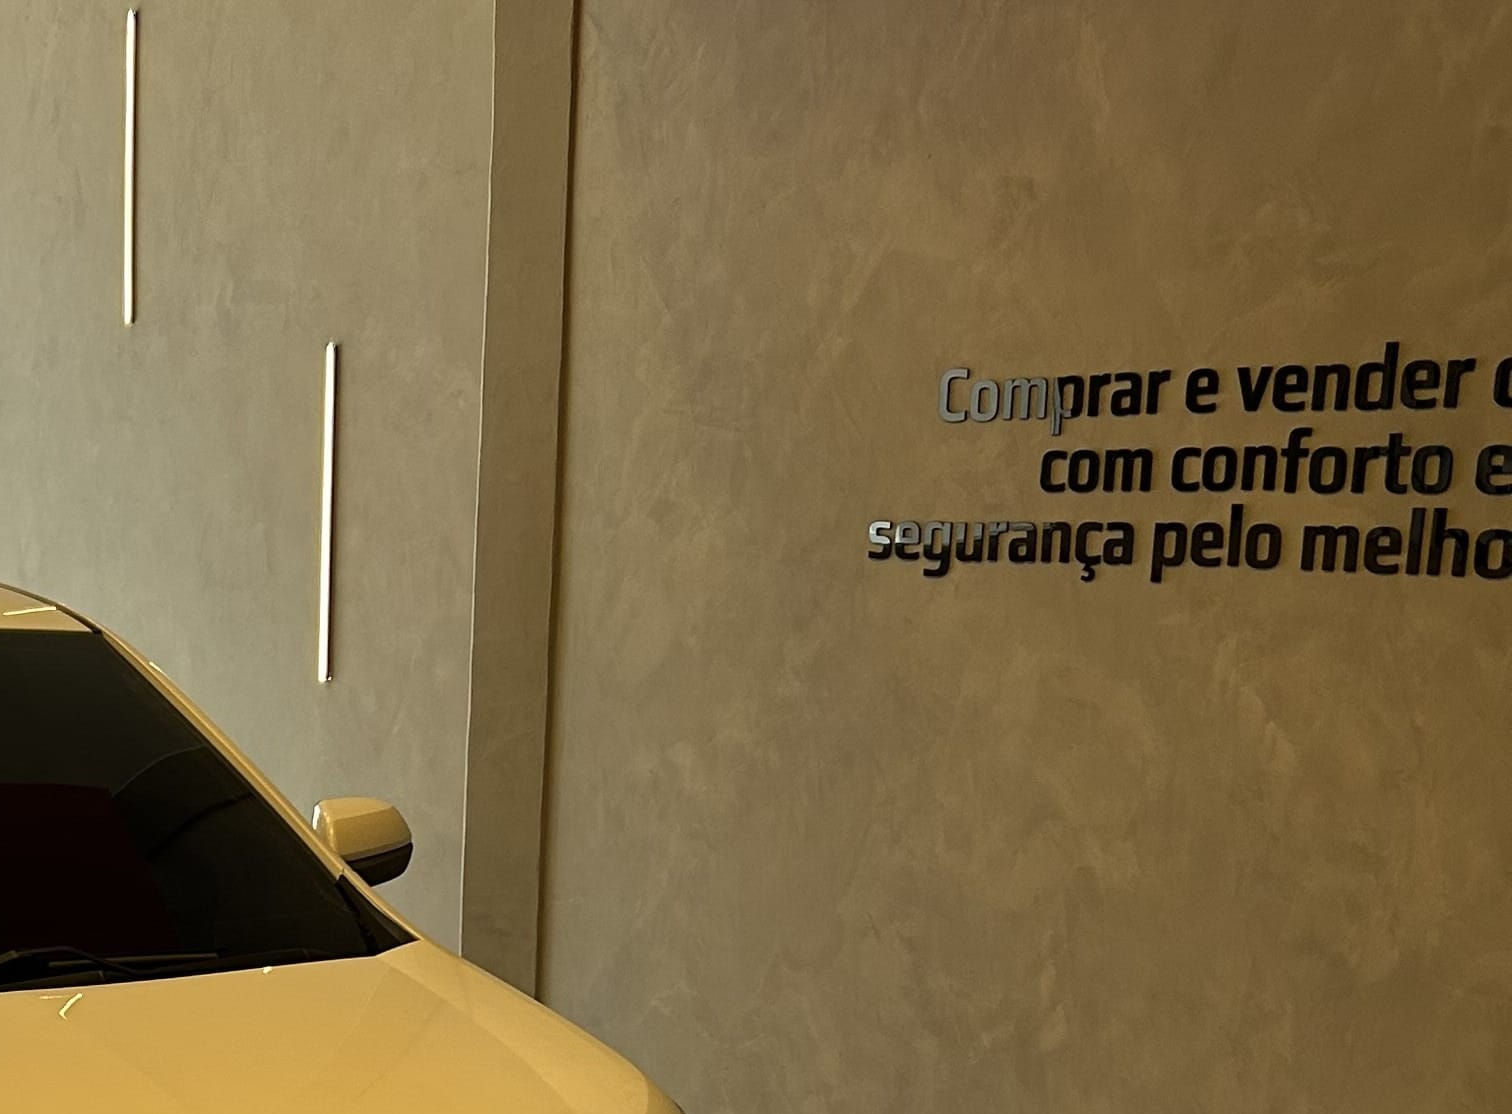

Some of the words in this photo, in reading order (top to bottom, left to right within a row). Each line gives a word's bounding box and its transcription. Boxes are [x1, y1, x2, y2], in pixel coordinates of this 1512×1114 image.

[938, 367, 1171, 436] Comprar
[1185, 368, 1220, 413] e
[1237, 341, 1476, 412] vender
[1040, 448, 1153, 493] com
[1171, 427, 1454, 495] conforto
[868, 520, 1135, 582] segurança
[1150, 503, 1282, 583] pelo
